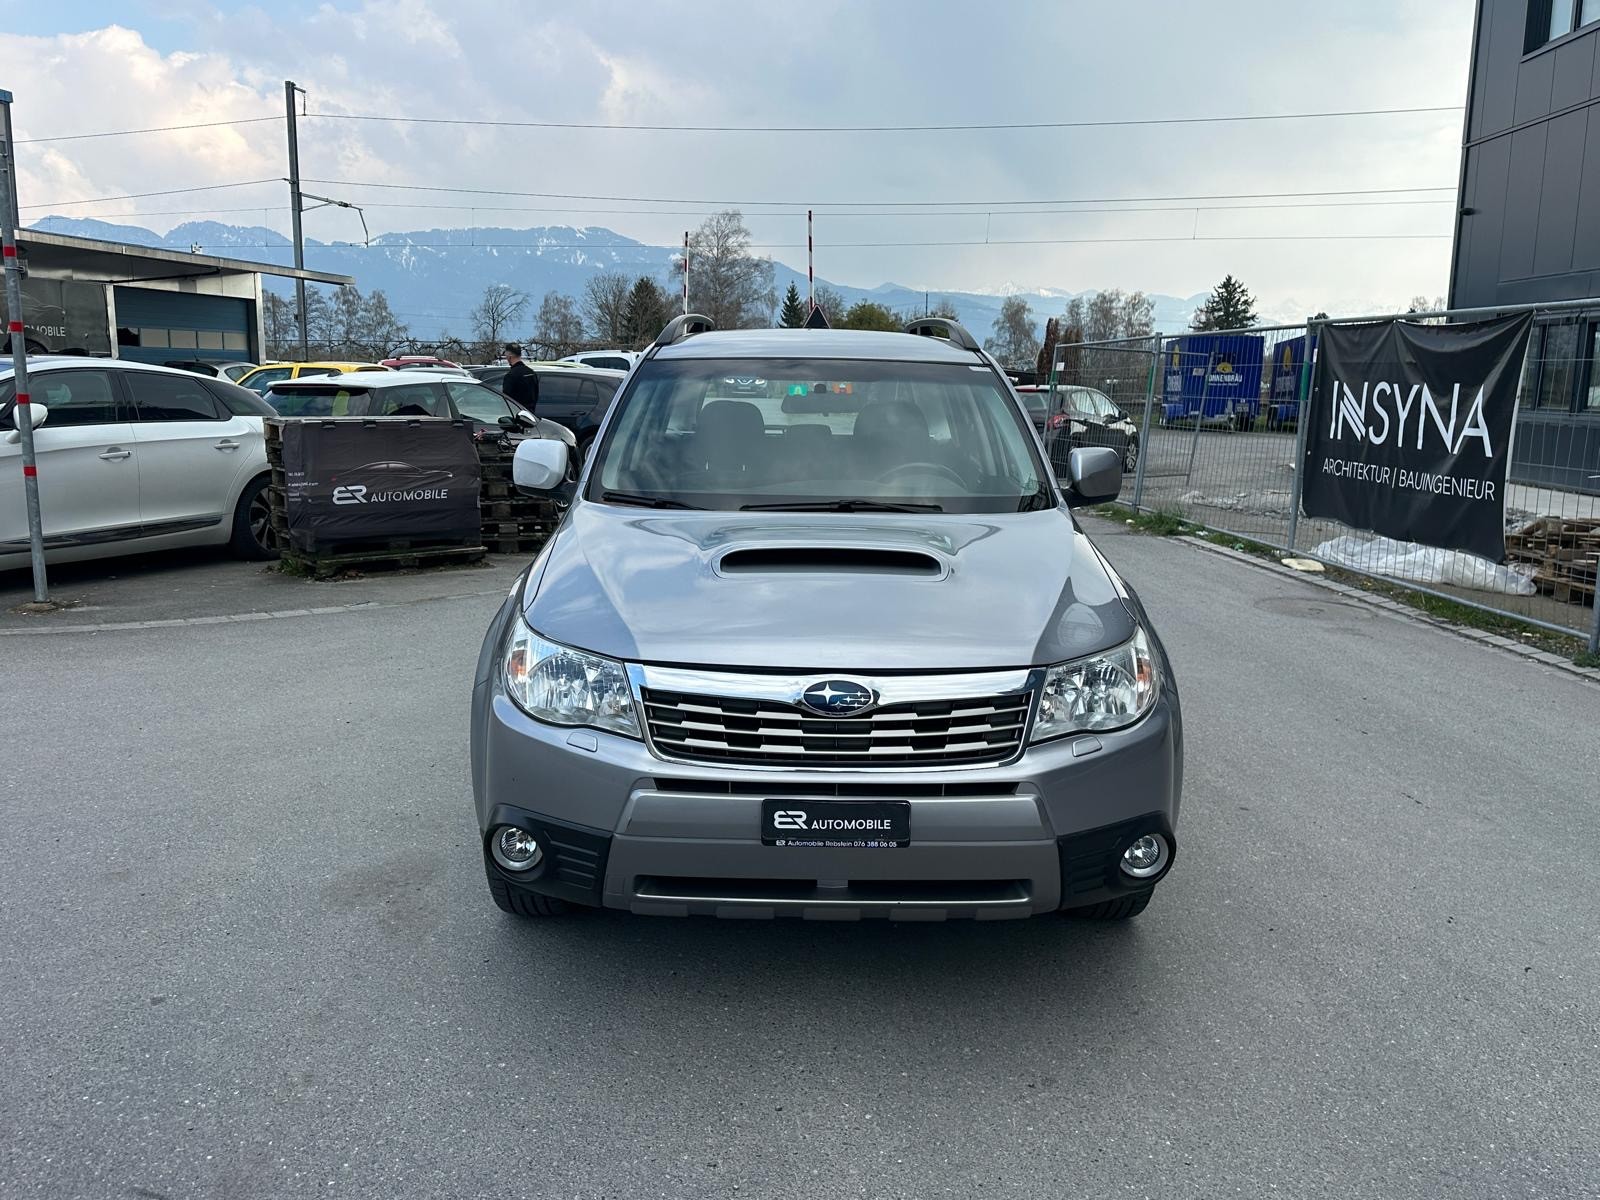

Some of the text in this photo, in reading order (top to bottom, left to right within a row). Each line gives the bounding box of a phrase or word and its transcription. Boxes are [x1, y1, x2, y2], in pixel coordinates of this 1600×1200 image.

[1329, 380, 1493, 458] INSYNA
[1322, 457, 1390, 485] ARCHITEKTUR
[1398, 469, 1495, 501] BAUINGENIEUR
[370, 489, 449, 503] AUTOMOBILE
[811, 819, 891, 830] AUTOMOBILE
